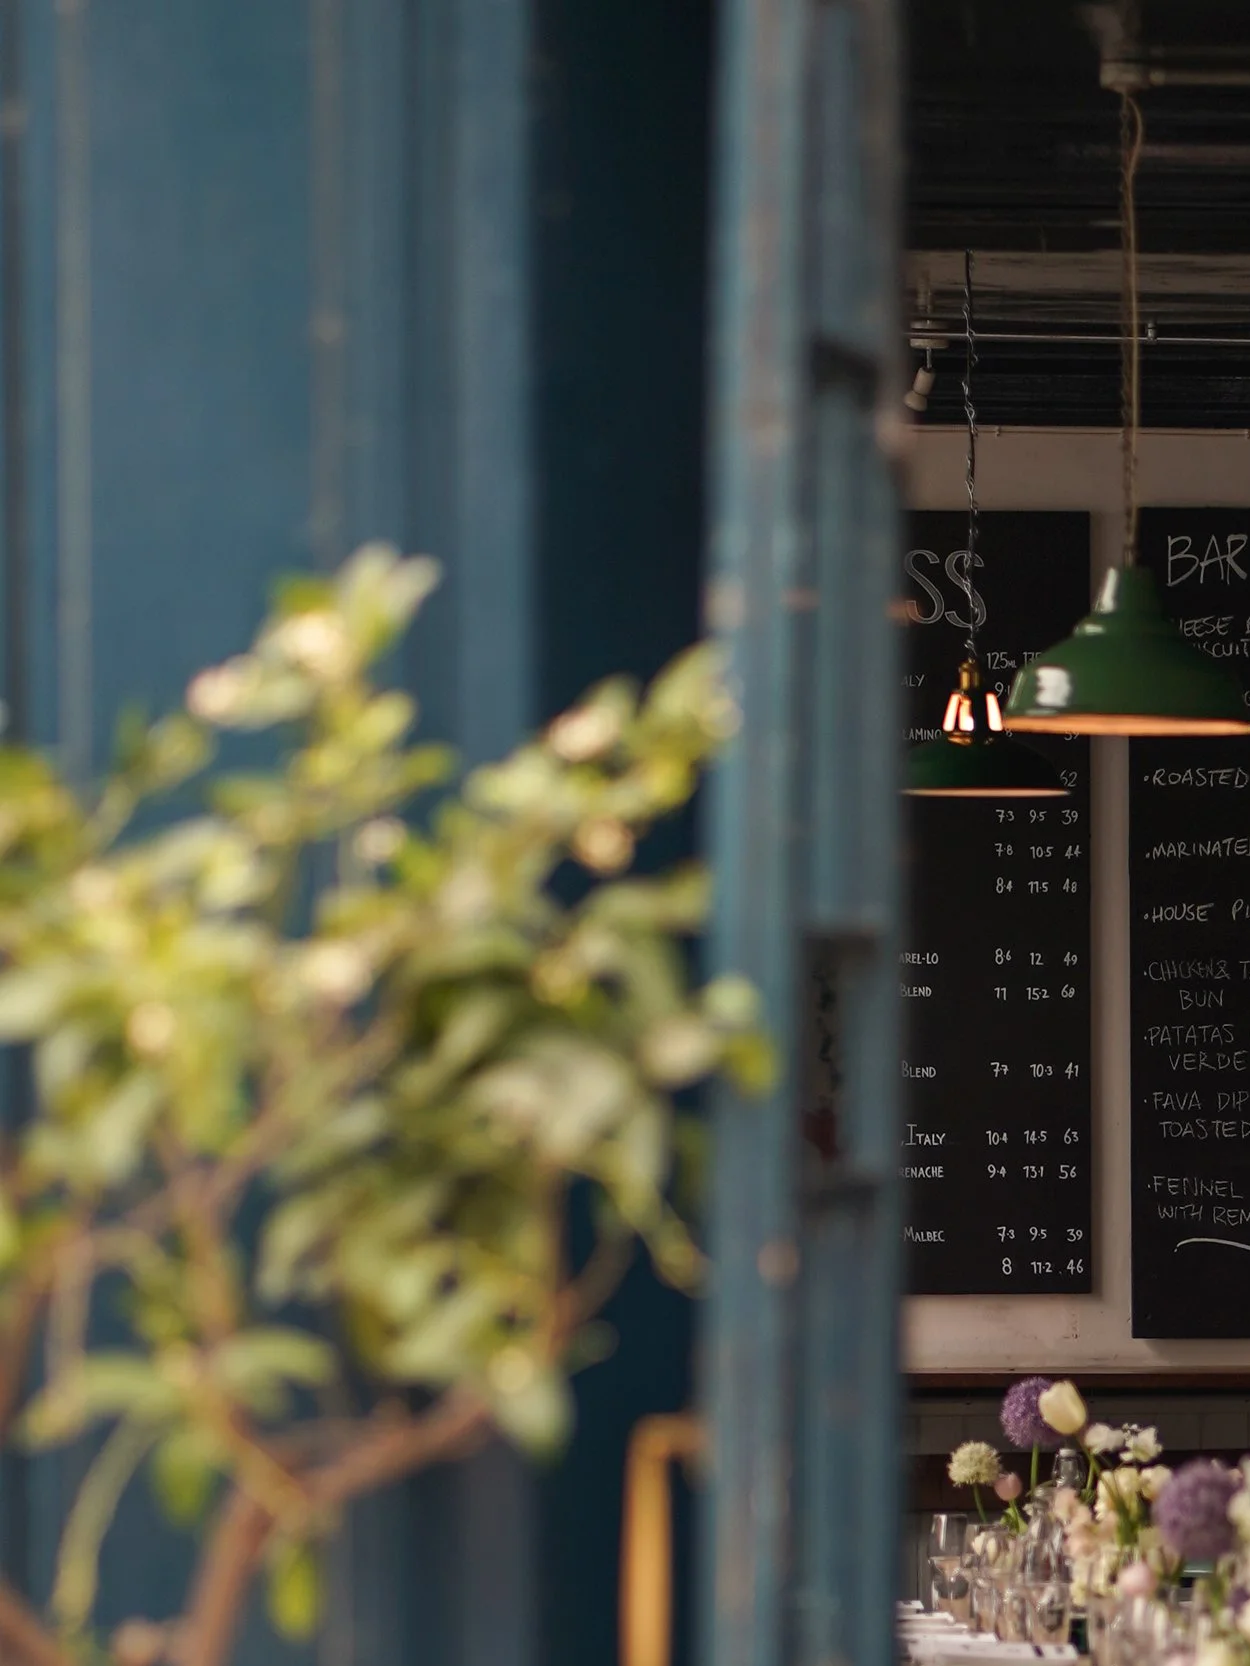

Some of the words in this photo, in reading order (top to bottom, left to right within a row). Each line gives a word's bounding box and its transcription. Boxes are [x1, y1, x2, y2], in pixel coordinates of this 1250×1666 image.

[1166, 533, 1248, 587] BAR
[903, 549, 987, 628] SS
[1179, 615, 1235, 637] EESE
[1152, 767, 1249, 789] ROASTED
[1061, 809, 1079, 825] 39
[1064, 844, 1082, 860] 44
[1062, 877, 1078, 894] 48
[1151, 902, 1215, 923] HOUSE
[899, 952, 940, 965] AREL-LO
[1029, 952, 1045, 965] 12
[1063, 951, 1078, 966] 49
[993, 986, 1008, 1001] 11
[1179, 989, 1225, 1010] BUN
[1147, 1023, 1235, 1046] PATATAS
[1064, 1061, 1080, 1079] 41
[1169, 1050, 1249, 1072] VERDE
[1152, 1090, 1203, 1110] FAVA
[1216, 1090, 1250, 1112] DIP
[1063, 1128, 1080, 1144] 63
[899, 1165, 944, 1178] RENACHE
[1058, 1164, 1077, 1179] 56
[1152, 1175, 1244, 1200] FENNEL
[1157, 1204, 1205, 1219] WITH
[1066, 1228, 1084, 1242] 39
[1001, 1257, 1013, 1275] 8
[1066, 1259, 1084, 1275] 46
